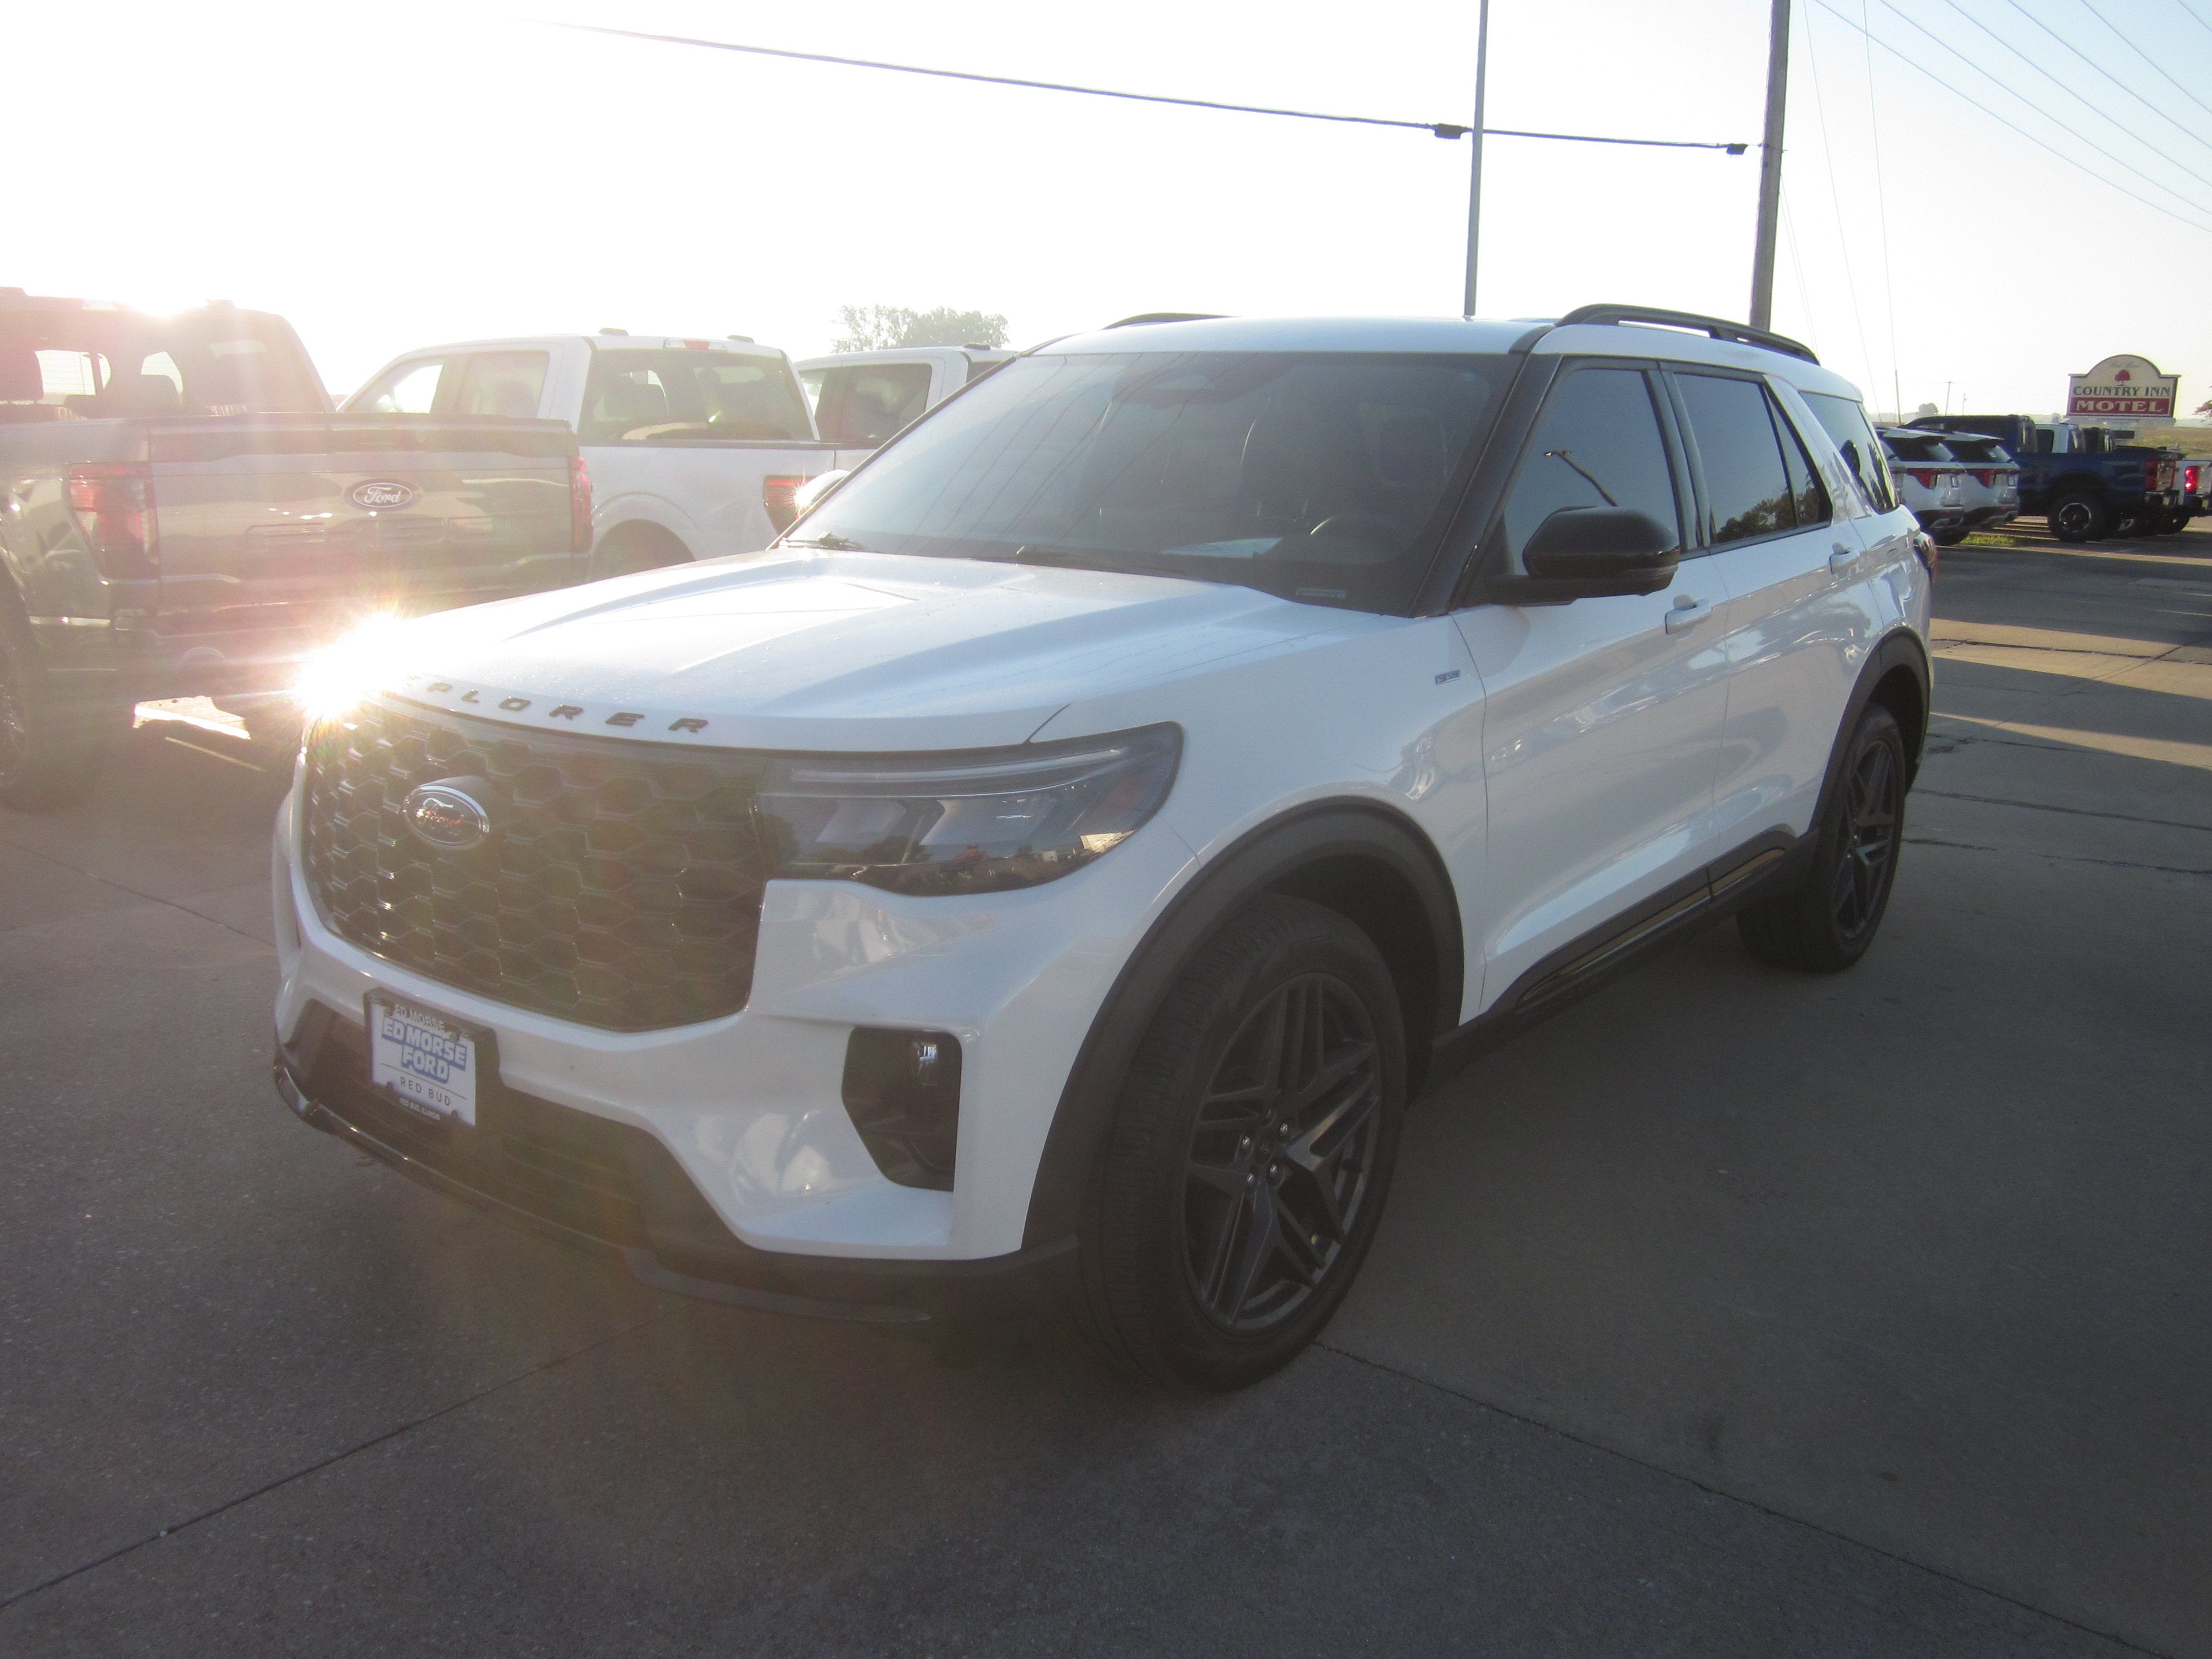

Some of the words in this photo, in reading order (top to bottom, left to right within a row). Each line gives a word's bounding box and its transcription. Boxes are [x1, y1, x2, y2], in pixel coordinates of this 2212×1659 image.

[2074, 386, 2140, 397] COUNTRY
[2145, 386, 2171, 397] INN
[2075, 400, 2164, 412] MOTEL
[364, 486, 402, 504] Ford
[402, 675, 709, 733] PLORER
[382, 1015, 405, 1042] ED
[405, 1023, 467, 1071] MORSE
[401, 1044, 450, 1084] FORD
[400, 1077, 422, 1093] RED
[429, 1088, 451, 1107] BUD
